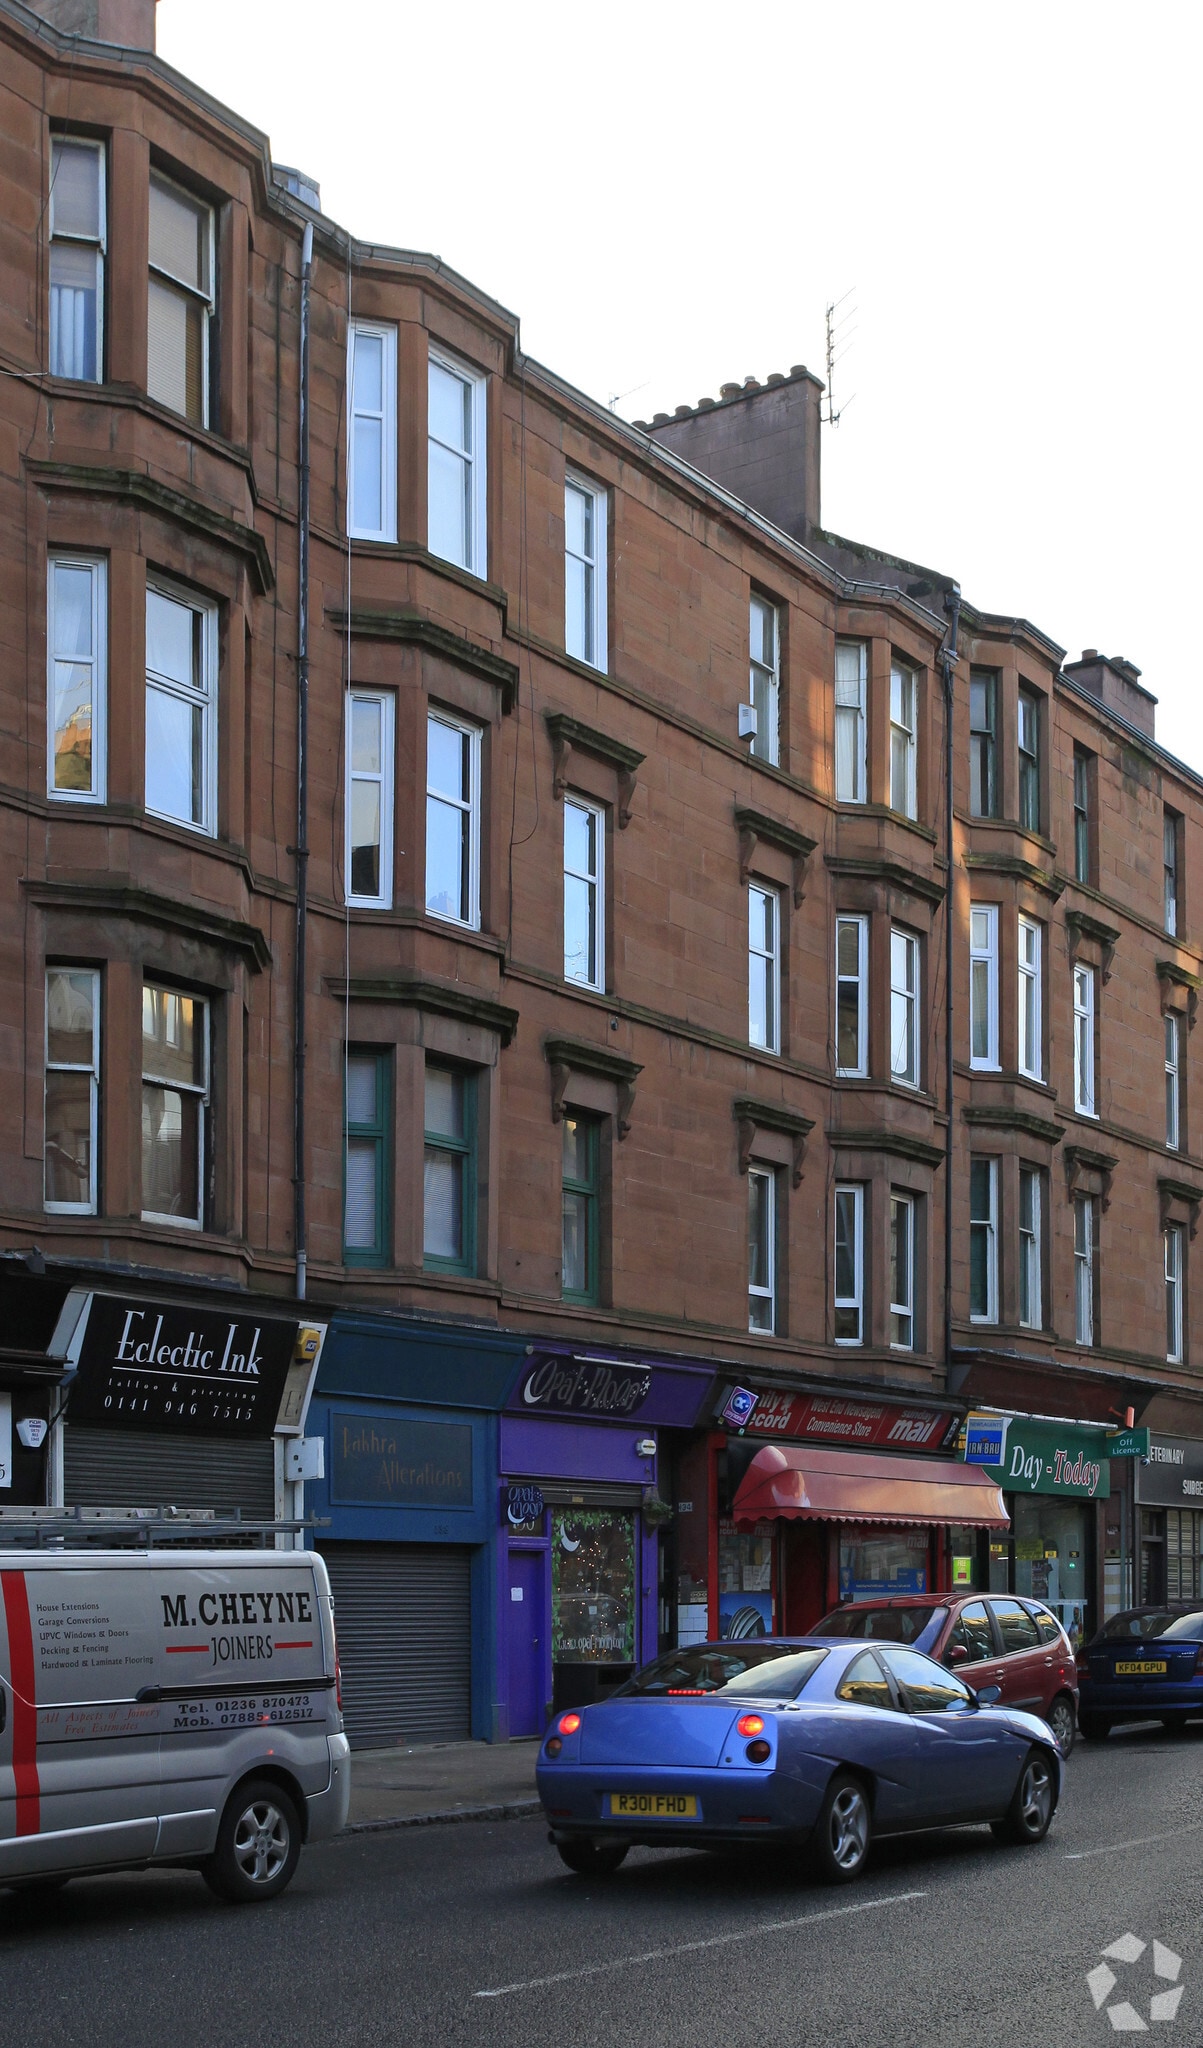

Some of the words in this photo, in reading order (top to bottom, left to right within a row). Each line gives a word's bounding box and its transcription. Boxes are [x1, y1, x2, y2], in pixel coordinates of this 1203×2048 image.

[115, 1310, 214, 1370] Eclectic
[218, 1323, 263, 1375] Ink
[108, 1378, 158, 1391] tattoo
[171, 1382, 179, 1393] &
[191, 1388, 256, 1402] piercing
[534, 1359, 586, 1406] Opal
[104, 1395, 148, 1411] 0141
[164, 1400, 198, 1416] 946
[212, 1405, 253, 1420] 7515
[810, 1398, 831, 1413] West
[830, 1401, 846, 1415] End
[844, 1402, 883, 1421] Newsagent
[748, 1412, 792, 1429] ecord
[901, 1410, 934, 1423] sunday
[806, 1416, 852, 1435] Convenience
[852, 1421, 873, 1437] Store
[887, 1414, 942, 1443] mail
[969, 1442, 1000, 1455] IRN-BRU
[1119, 1438, 1133, 1447] Off
[1112, 1447, 1141, 1456] Licence
[1150, 1445, 1184, 1465] ETERINARY
[907, 1532, 929, 1549] mail
[37, 1603, 59, 1612] House
[62, 1602, 99, 1611] Extensions
[161, 1592, 313, 1627] M.CHEYNE
[38, 1618, 64, 1627] Garage
[67, 1616, 110, 1625] Conversions
[40, 1631, 61, 1640] UPVC
[63, 1630, 96, 1639] Windows
[99, 1630, 105, 1638] &
[108, 1629, 129, 1637] Doors
[41, 1647, 70, 1655] Decking
[82, 1644, 109, 1653] Fencing
[211, 1634, 273, 1666] JOINERS
[42, 1660, 79, 1669] Hardwood
[91, 1658, 122, 1667] Laminate
[125, 1655, 154, 1665] Flooring
[1118, 1663, 1142, 1672] KF04
[1144, 1662, 1163, 1672] GPU
[179, 1703, 209, 1714] Tel.
[215, 1700, 256, 1712] 01236
[262, 1696, 310, 1708] 870473
[42, 1712, 59, 1723] All
[66, 1711, 103, 1722] Aspects
[109, 1710, 118, 1721] of
[125, 1708, 160, 1720] Joinery
[174, 1716, 214, 1728] Mob.
[220, 1712, 263, 1724] 07885
[270, 1708, 313, 1720] 612517
[65, 1725, 85, 1735] Free
[92, 1723, 139, 1733] Estimates
[619, 1795, 652, 1811] R301
[655, 1796, 687, 1813] FHD
